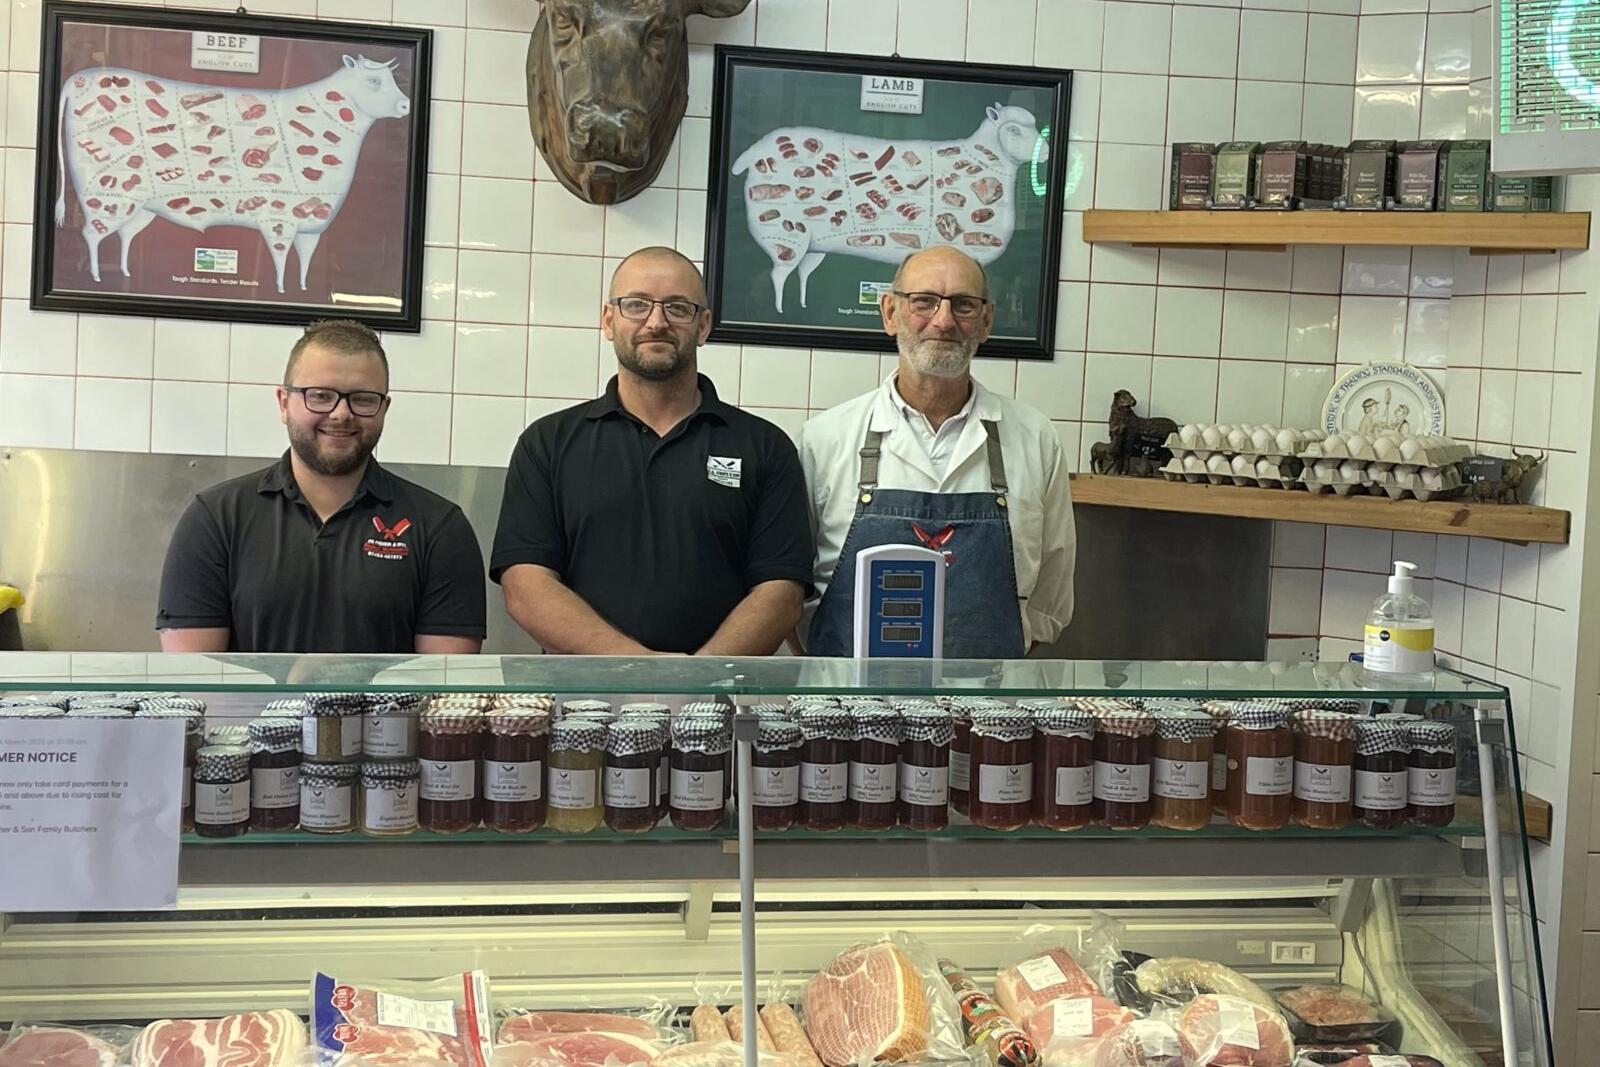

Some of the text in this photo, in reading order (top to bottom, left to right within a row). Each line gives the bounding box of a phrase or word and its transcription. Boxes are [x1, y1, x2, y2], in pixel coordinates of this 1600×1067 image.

[206, 35, 248, 49] BEEF
[871, 78, 914, 91] LAMB
[1373, 364, 1419, 382] STANDARDS
[0, 752, 78, 763] MER NOTICE
[17, 782, 33, 790] only
[72, 781, 109, 790] payments
[111, 780, 121, 788] for
[71, 792, 92, 800] rising
[111, 791, 121, 799] for
[38, 825, 62, 834] Family
[64, 825, 98, 833] Butchers
